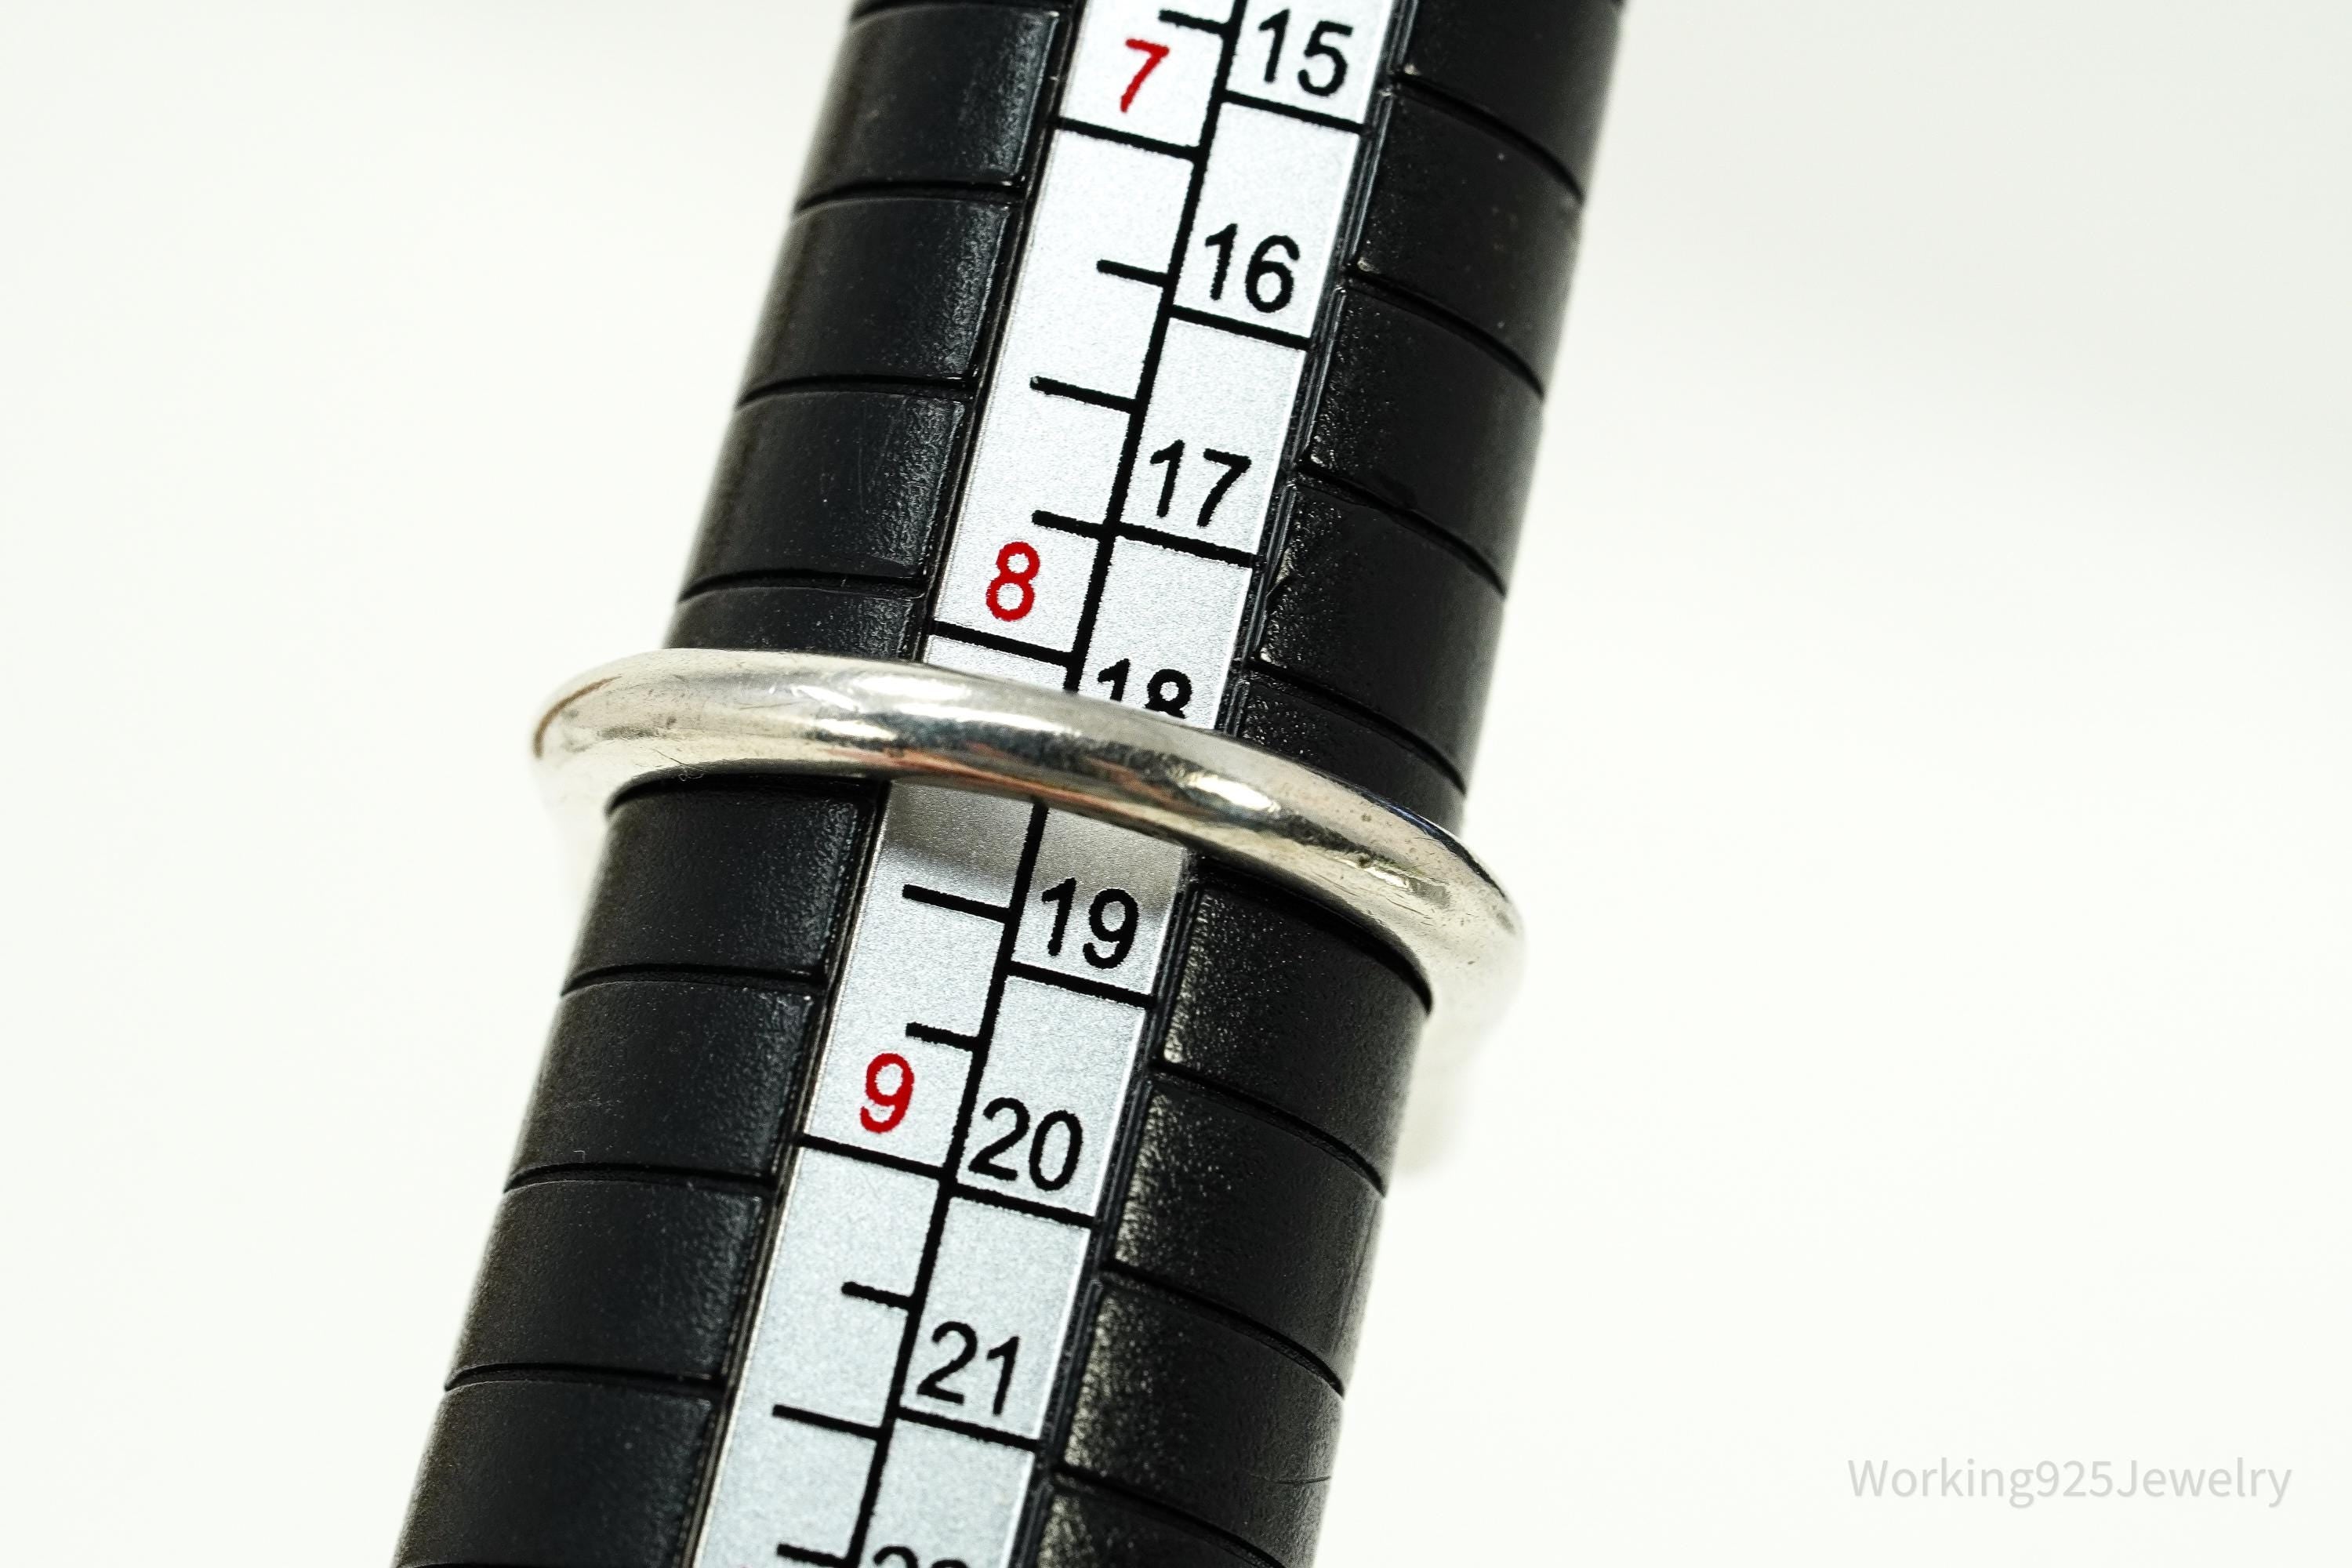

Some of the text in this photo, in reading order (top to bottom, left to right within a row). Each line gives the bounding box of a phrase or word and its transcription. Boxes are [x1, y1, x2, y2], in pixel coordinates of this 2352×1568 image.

[1120, 38, 1170, 112] 7
[1258, 9, 1353, 97] 15
[1204, 223, 1301, 314] 16
[1149, 439, 1252, 528] 17
[985, 541, 1040, 622] 8
[1040, 877, 1141, 971] 19
[860, 1053, 915, 1134] 9
[967, 1097, 1083, 1192] 20
[916, 1320, 1020, 1417] 21
